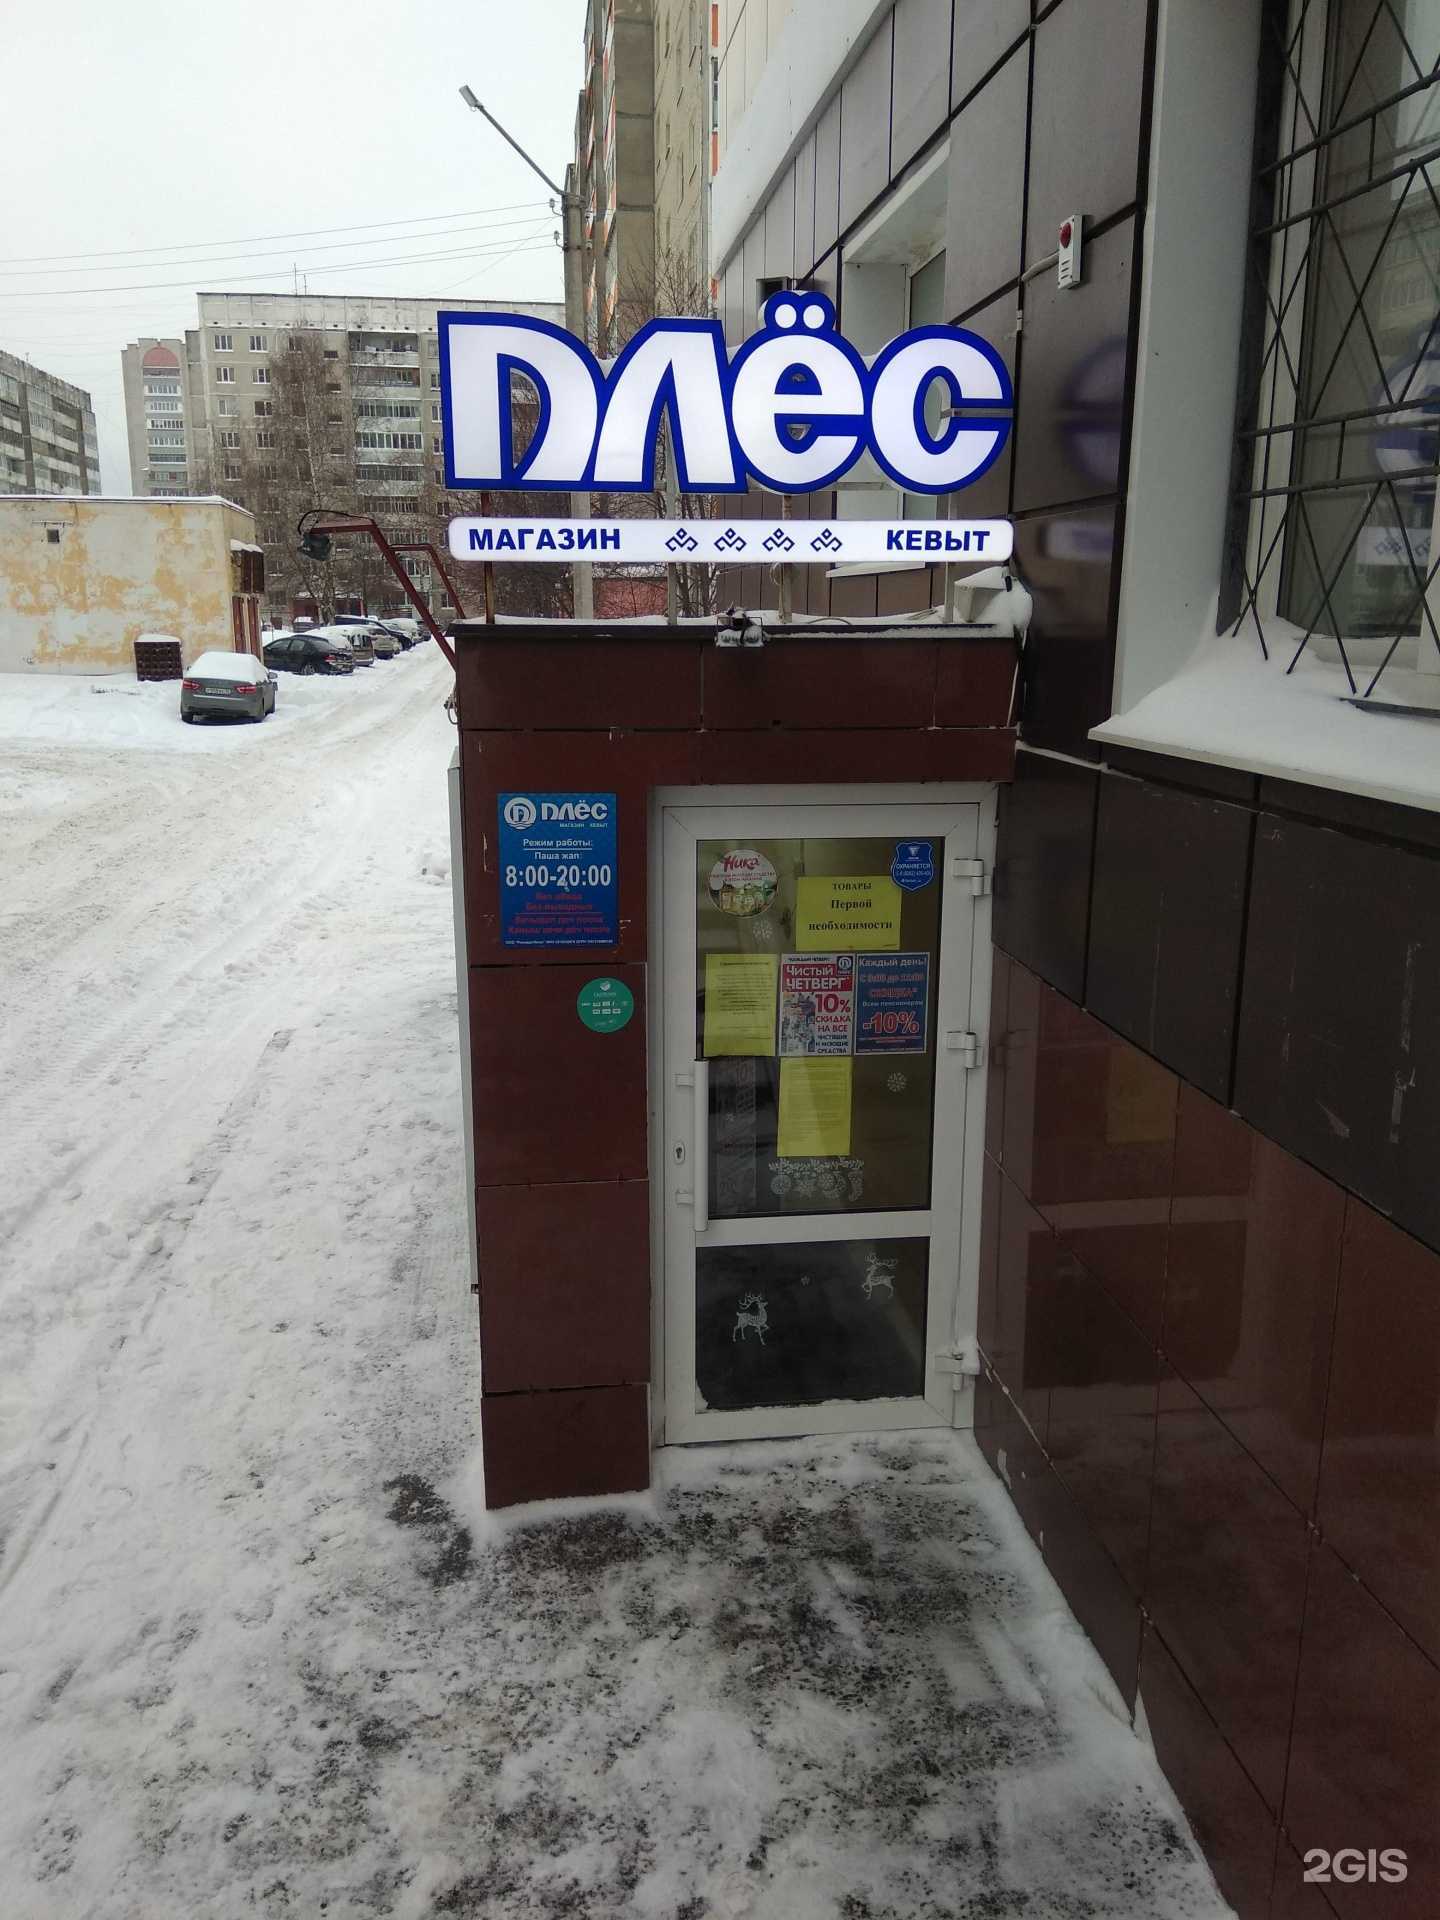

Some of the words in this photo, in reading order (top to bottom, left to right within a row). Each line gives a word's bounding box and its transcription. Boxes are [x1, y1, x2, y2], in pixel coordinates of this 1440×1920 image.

[468, 528, 621, 551] МАГАЗИН
[886, 529, 990, 553] КЕВЫТ
[523, 838, 554, 847] Режим
[556, 838, 593, 848] работы:
[534, 851, 560, 860] Паша
[505, 864, 612, 887] 8:00-20:00
[831, 898, 872, 911] Первой
[808, 920, 893, 931] необходимости
[860, 958, 898, 967] Каждый
[815, 993, 851, 1013] 10%
[815, 1015, 851, 1023] СКИДКА
[863, 1011, 920, 1034] -10%
